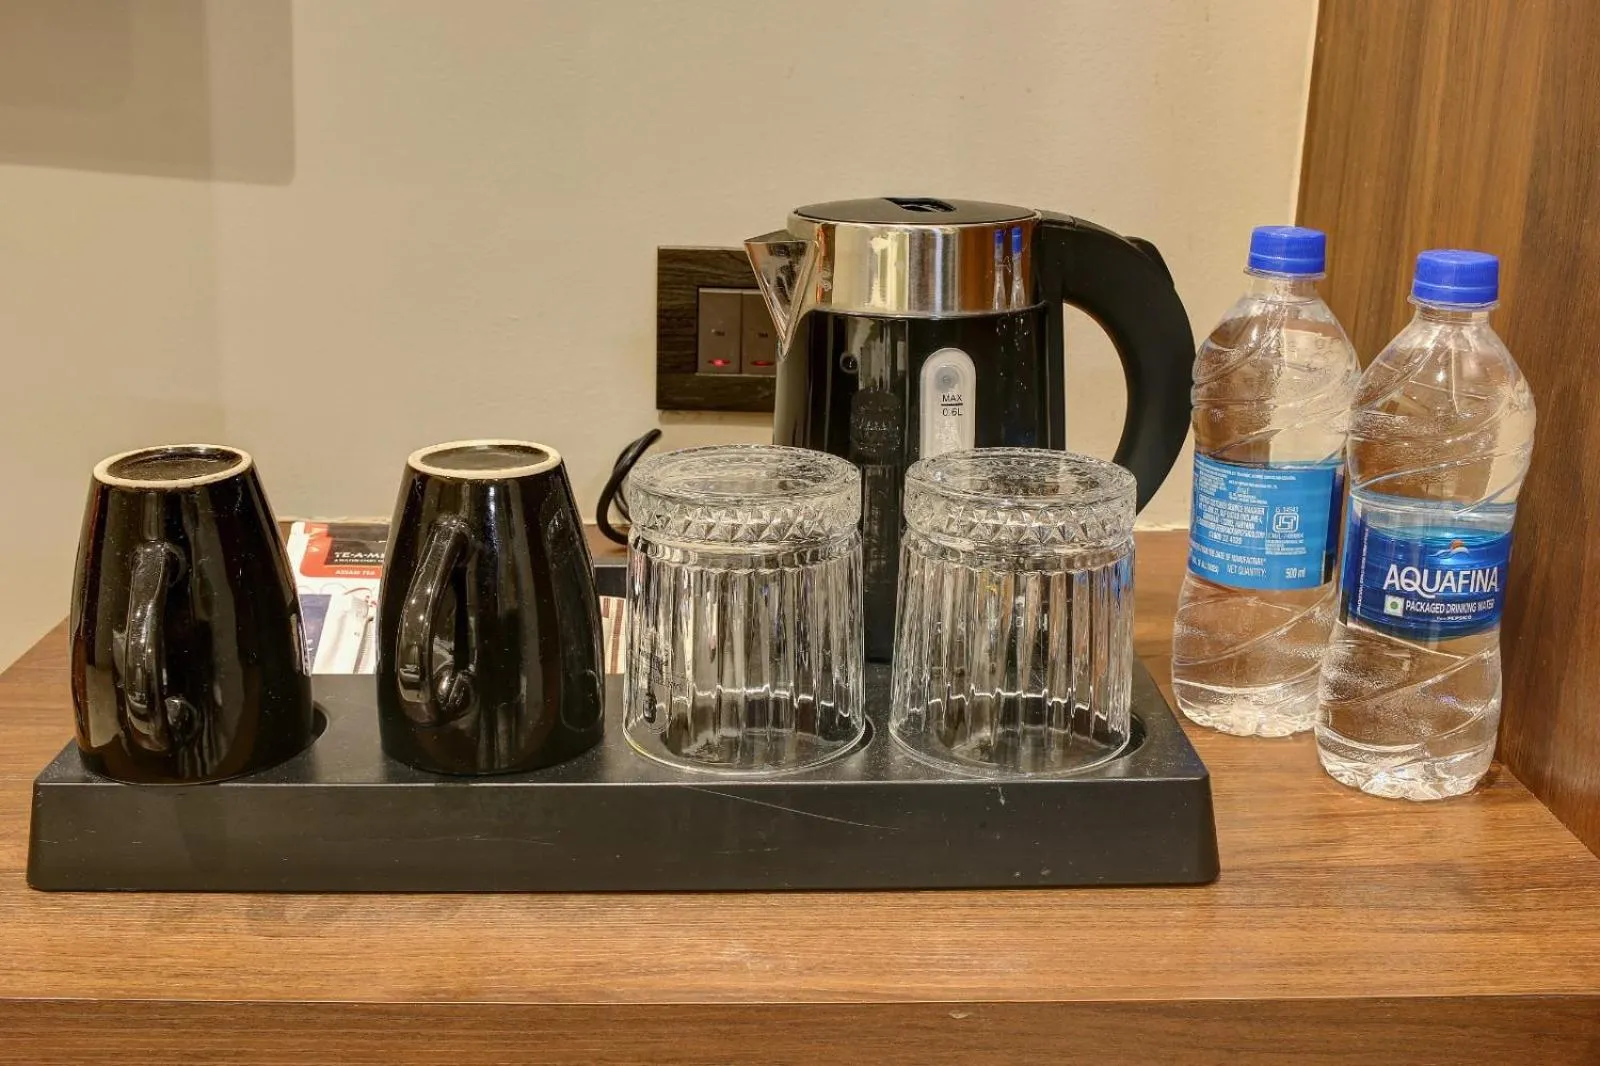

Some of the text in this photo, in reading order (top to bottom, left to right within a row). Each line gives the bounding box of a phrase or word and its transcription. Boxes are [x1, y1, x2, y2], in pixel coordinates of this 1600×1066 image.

[942, 393, 963, 402] MAX
[1285, 568, 1297, 579] 500
[1382, 563, 1500, 599] AQUAFINA
[1405, 598, 1496, 614] PACKAGED DRINKING WATER
